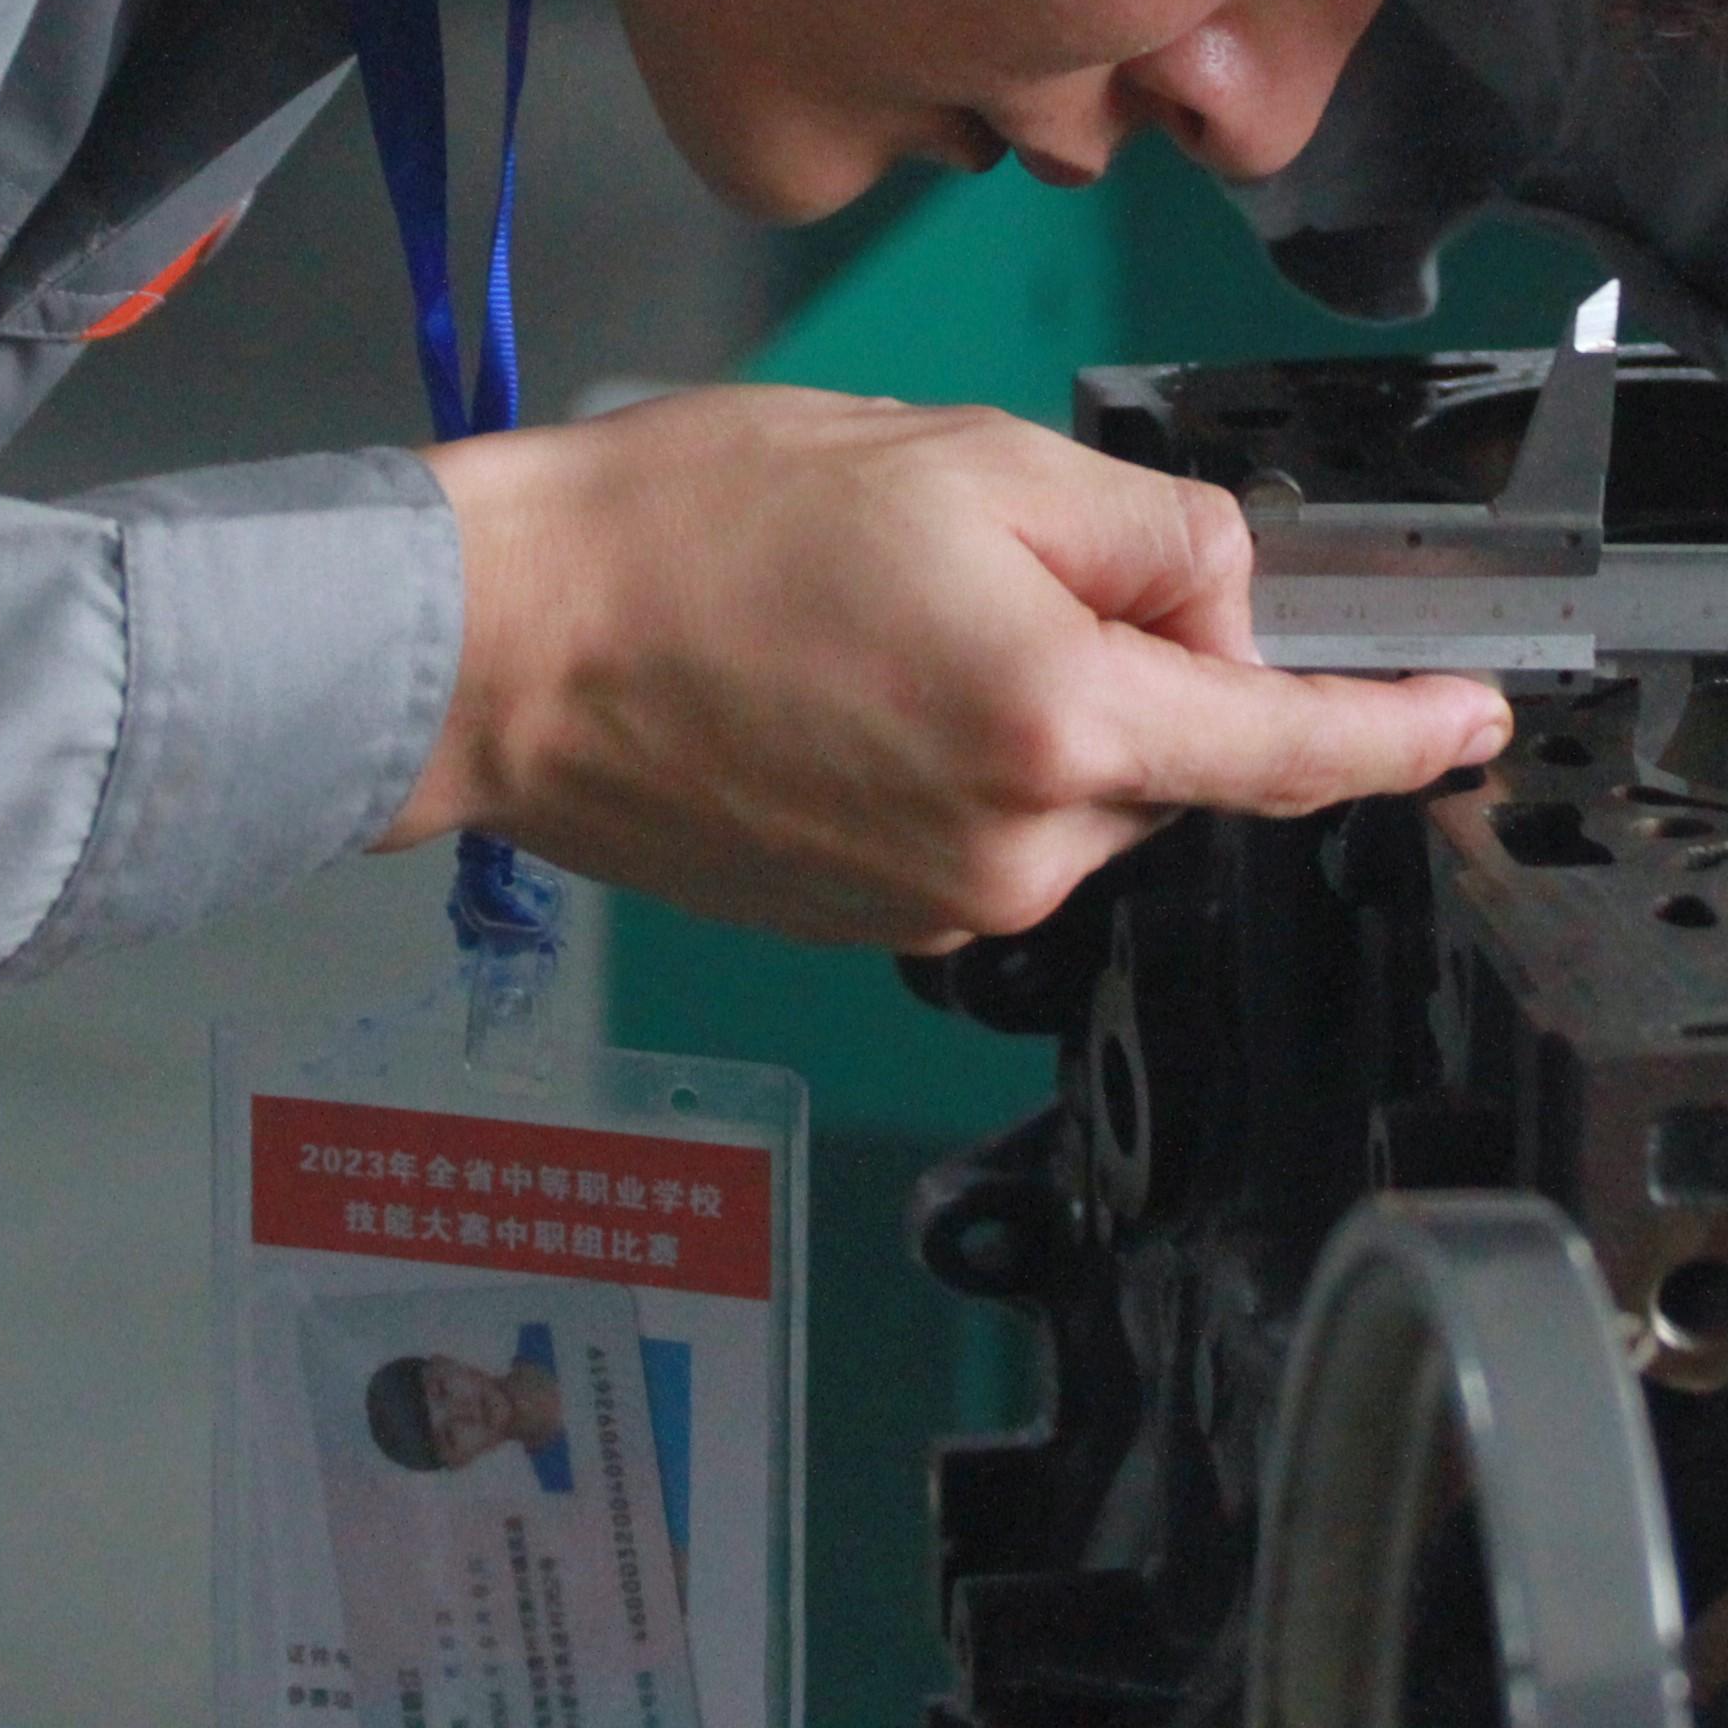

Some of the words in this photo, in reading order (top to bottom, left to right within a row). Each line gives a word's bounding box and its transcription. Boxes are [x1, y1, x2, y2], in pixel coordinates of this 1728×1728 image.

[299, 1143, 723, 1219] 2023年全省中等职业学校
[344, 1201, 681, 1267] 技能大赛中职组比赛
